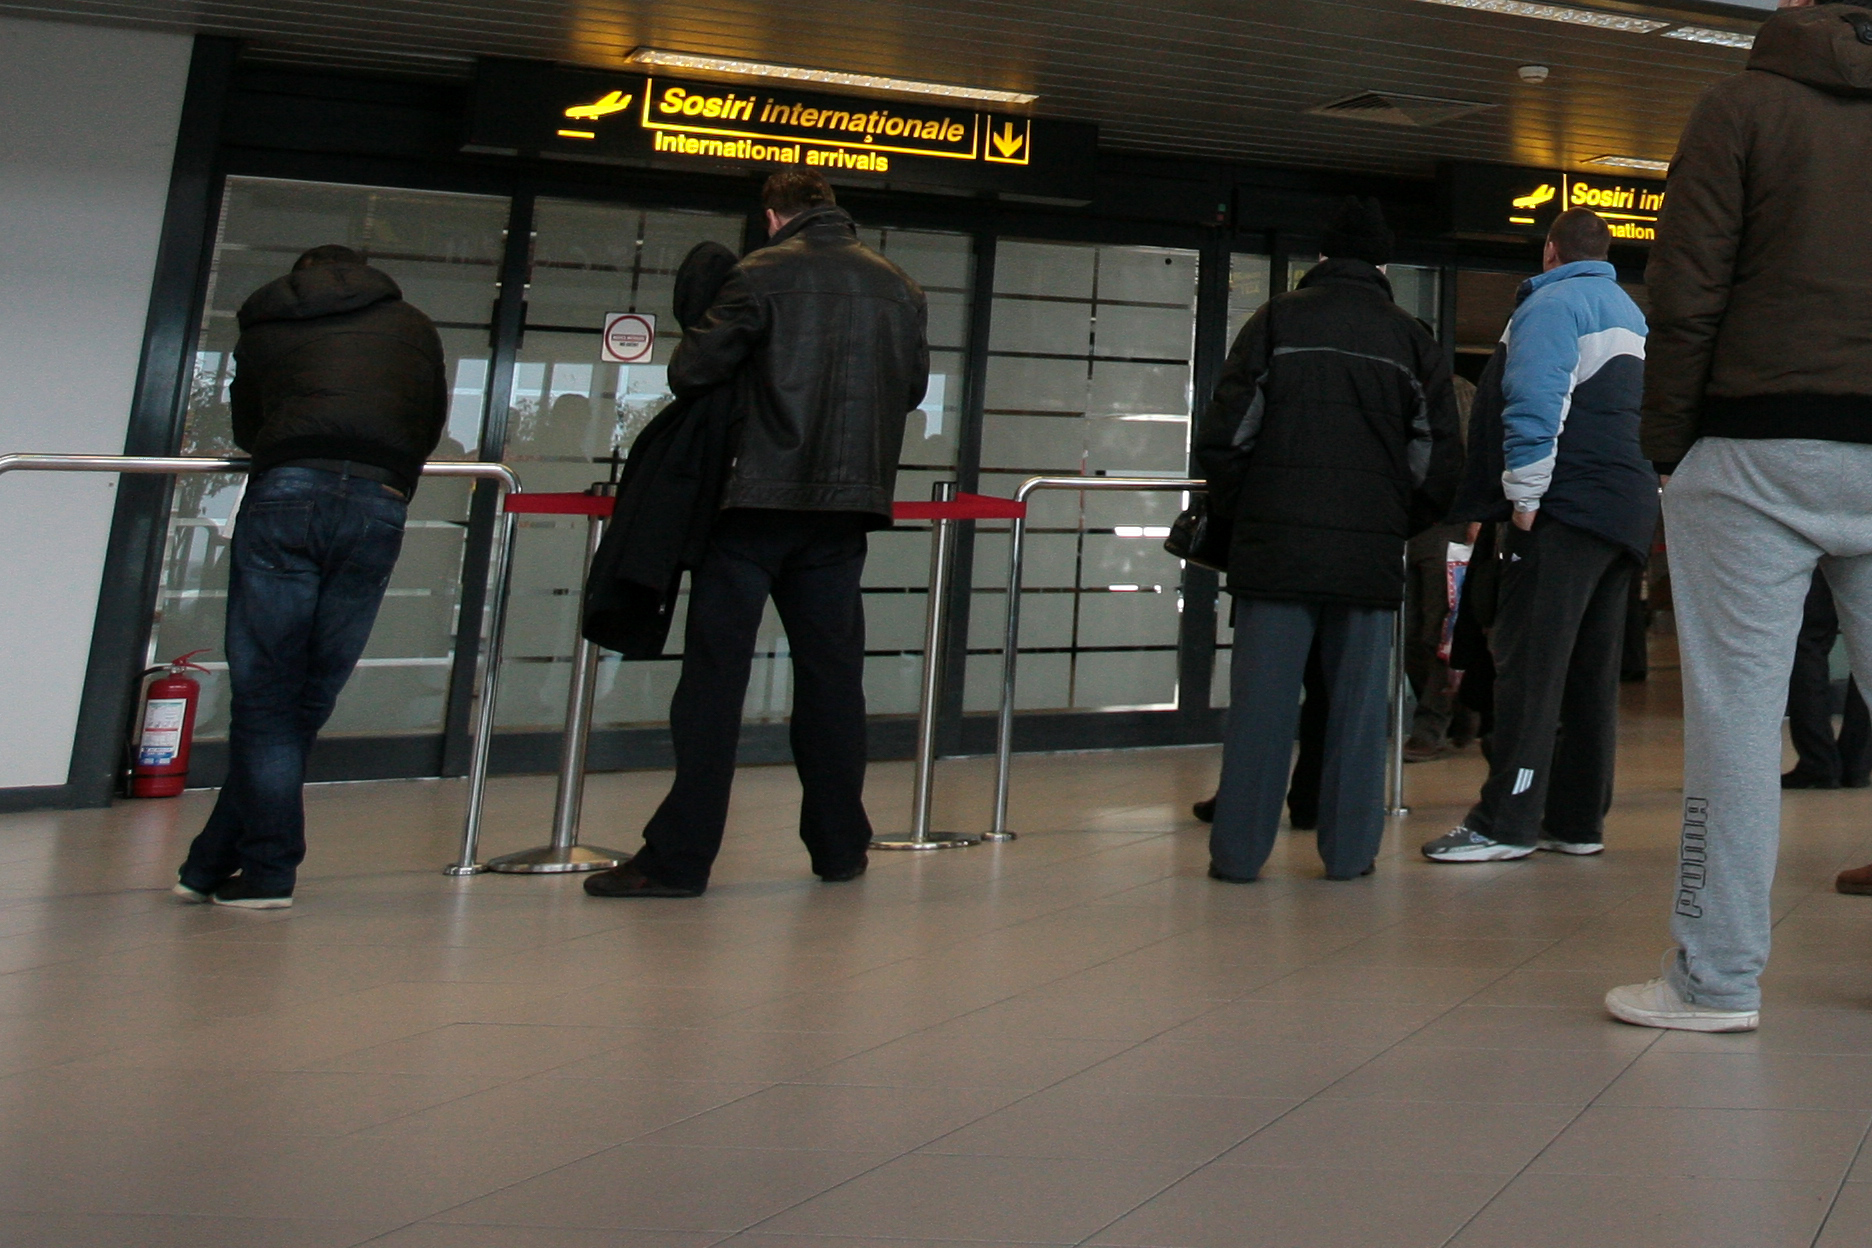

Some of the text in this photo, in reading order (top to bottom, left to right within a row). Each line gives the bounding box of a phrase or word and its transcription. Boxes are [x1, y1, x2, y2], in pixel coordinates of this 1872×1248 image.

[660, 87, 756, 121] Sosiri
[655, 131, 889, 172] International arrivals
[1571, 181, 1636, 209] Sosiri
[1675, 797, 1709, 919] PUMA
